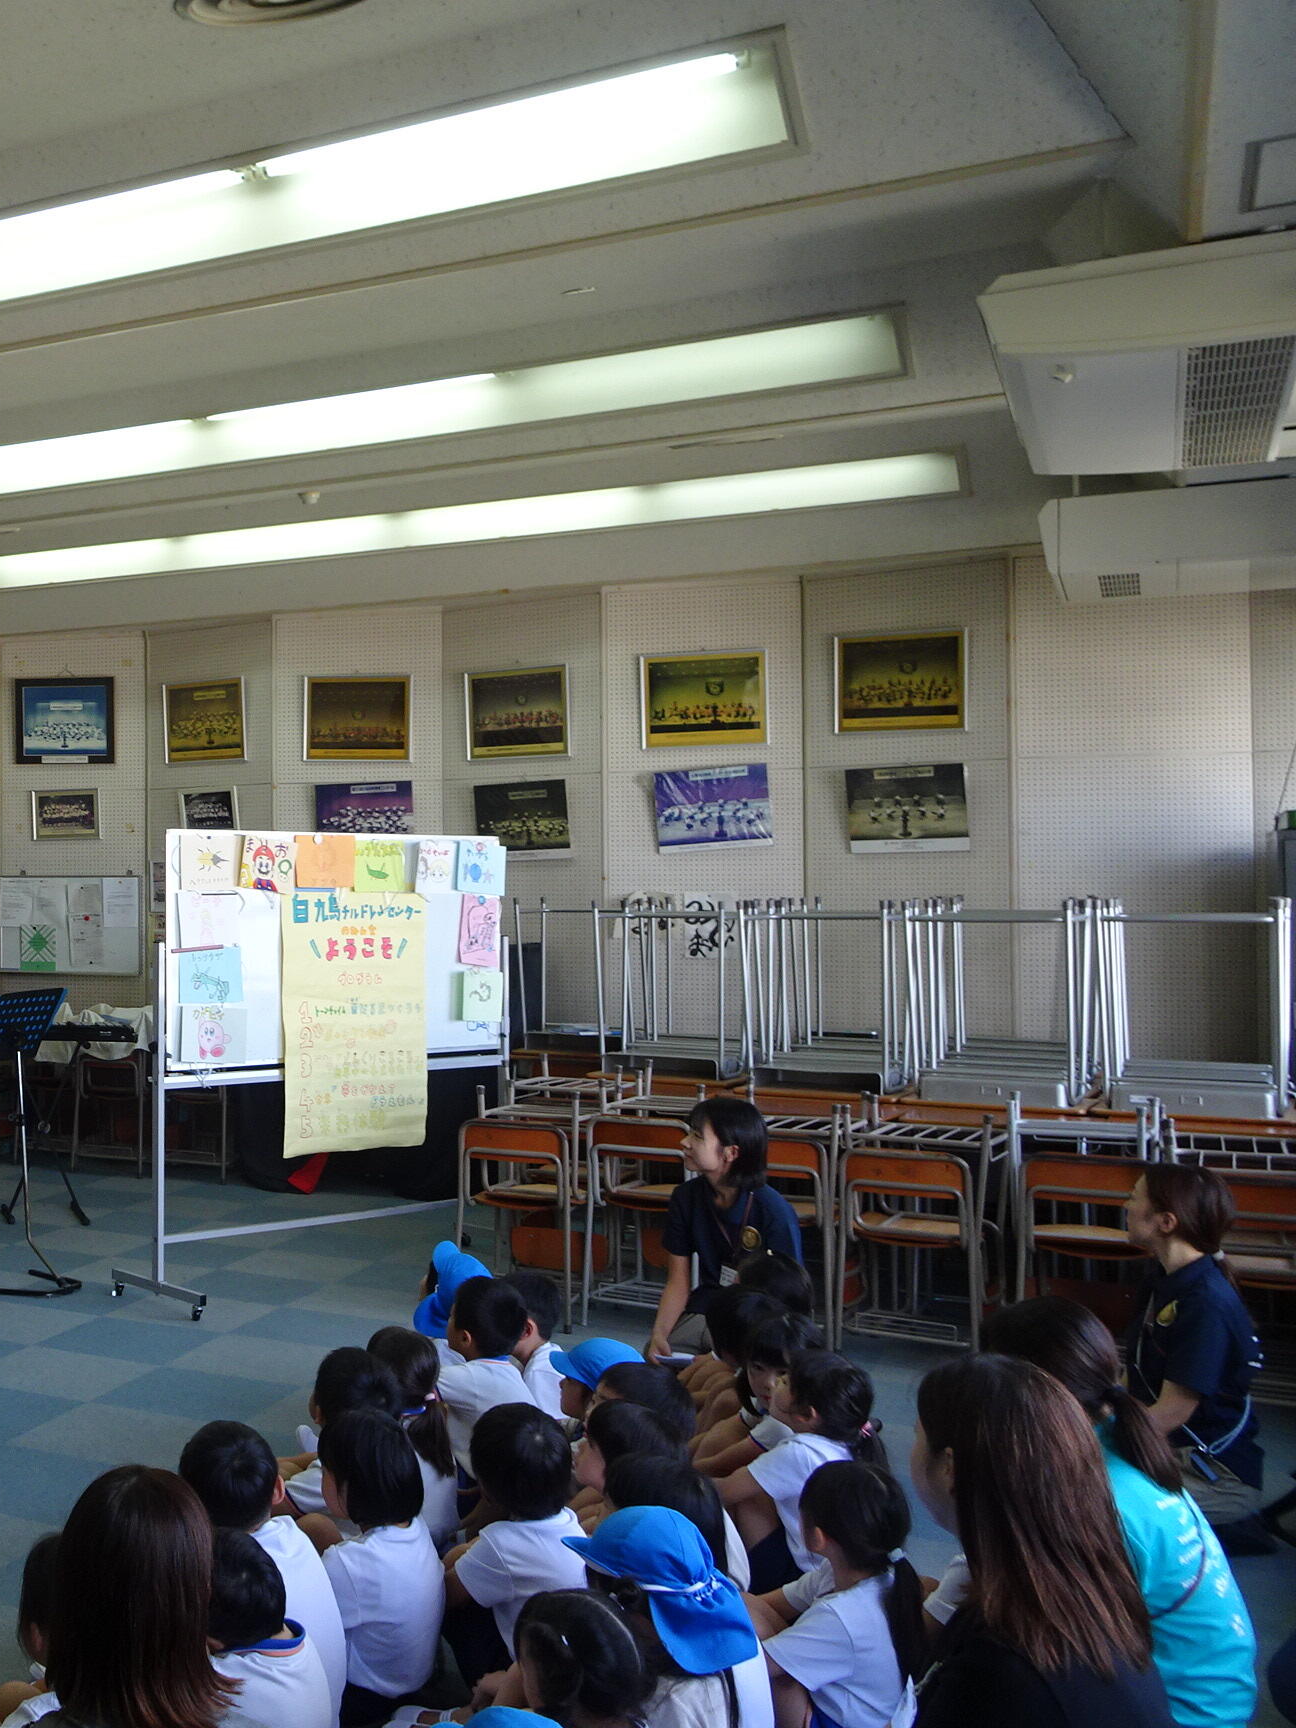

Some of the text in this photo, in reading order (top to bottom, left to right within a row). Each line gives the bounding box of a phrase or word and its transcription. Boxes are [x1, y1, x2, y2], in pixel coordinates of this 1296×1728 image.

[325, 936, 393, 961] ようこそ
[299, 1026, 314, 1049] 2
[298, 1088, 315, 1112] 4
[299, 1114, 314, 1139] 5
